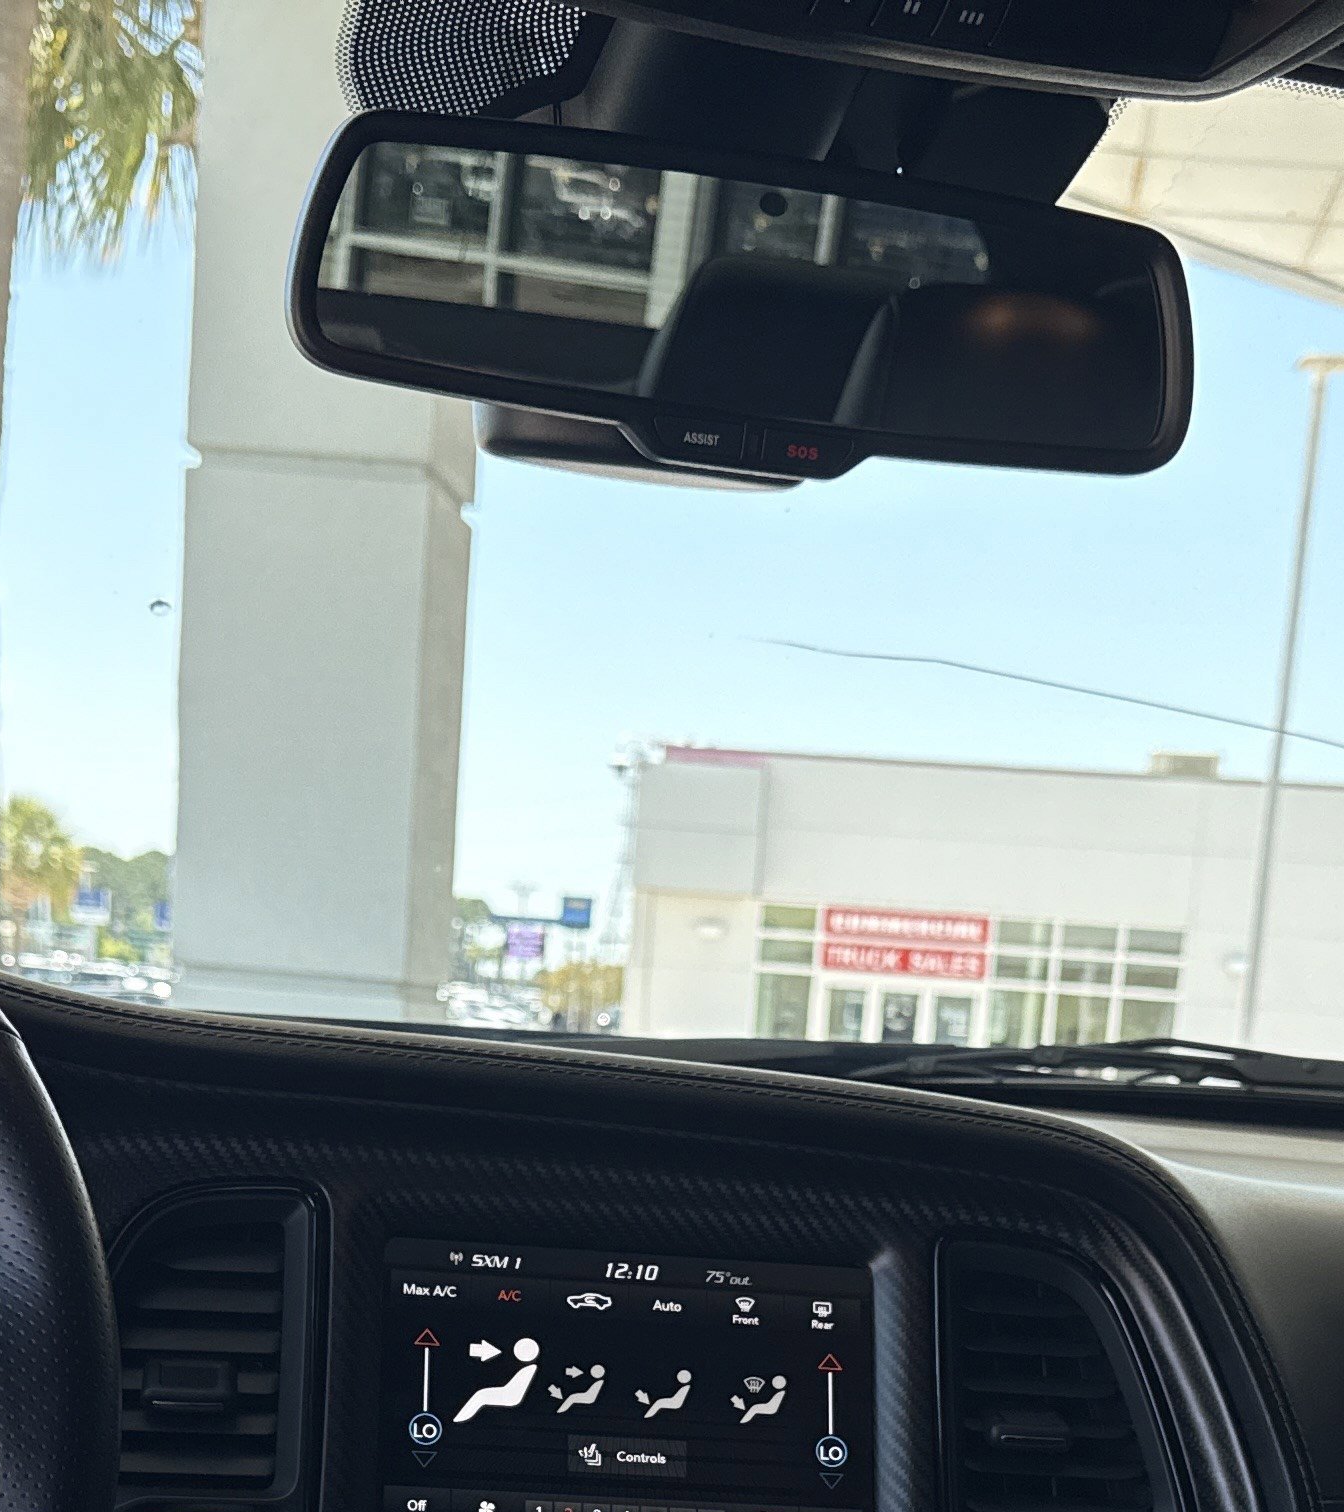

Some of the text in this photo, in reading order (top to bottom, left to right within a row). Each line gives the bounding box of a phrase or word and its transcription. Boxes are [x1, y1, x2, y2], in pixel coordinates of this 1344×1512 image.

[683, 431, 720, 447] ASSIST
[786, 444, 818, 460] SOS
[471, 1254, 522, 1270] SXM 1
[606, 1263, 659, 1281] 12:10
[403, 1283, 457, 1298] Max A/C
[498, 1289, 522, 1302] A/C
[653, 1300, 682, 1313] Auto
[732, 1315, 759, 1326] Front
[811, 1320, 834, 1331] Rear
[413, 1423, 438, 1440] LO
[616, 1450, 667, 1466] Controls
[820, 1447, 843, 1463] LO
[407, 1499, 427, 1512] Off
